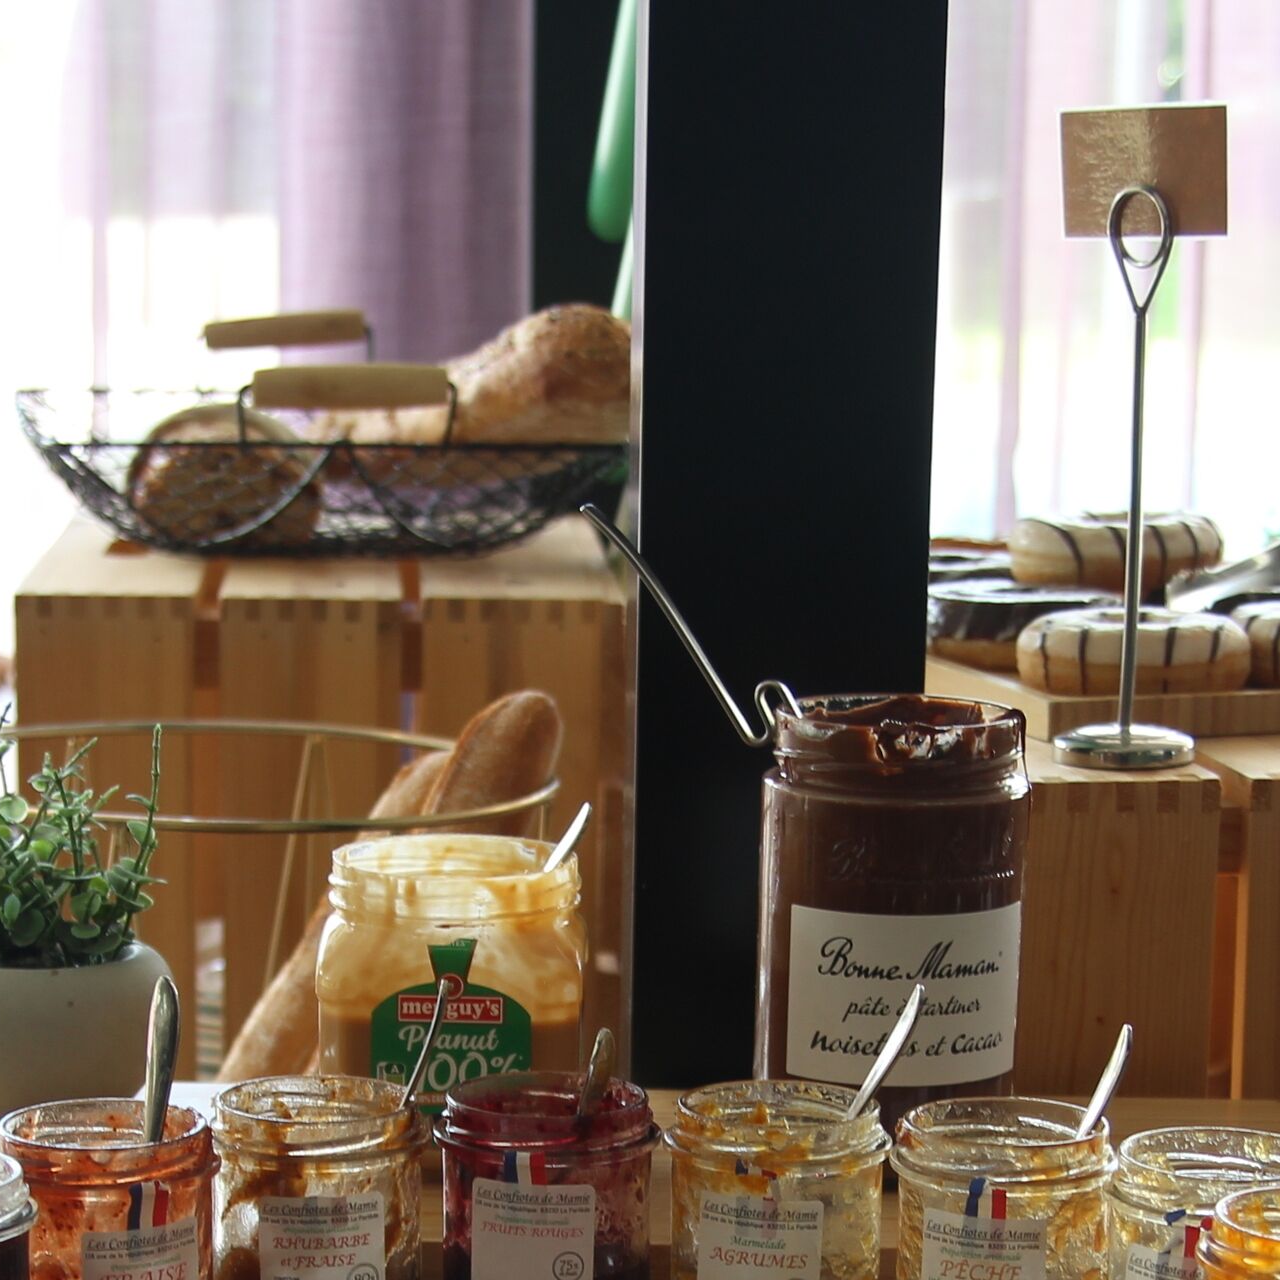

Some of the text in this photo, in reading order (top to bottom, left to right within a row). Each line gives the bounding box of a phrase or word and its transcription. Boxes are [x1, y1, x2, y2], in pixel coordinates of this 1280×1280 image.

[818, 937, 998, 980] Bonne Maman
[402, 998, 500, 1019] meguy's
[842, 996, 891, 1022] pâte
[918, 996, 981, 1017] tartiner
[398, 1025, 499, 1051] Panut
[811, 1031, 1002, 1056] noisets et Cacao
[541, 1192, 552, 1203] de
[331, 1203, 342, 1214] de
[768, 1209, 780, 1220] de
[272, 1233, 371, 1250] RHUBARBE
[990, 1228, 1003, 1239] de
[729, 1235, 787, 1250] Marmelade
[280, 1253, 357, 1270] et FRAISE
[709, 1247, 808, 1269] AGRUMES
